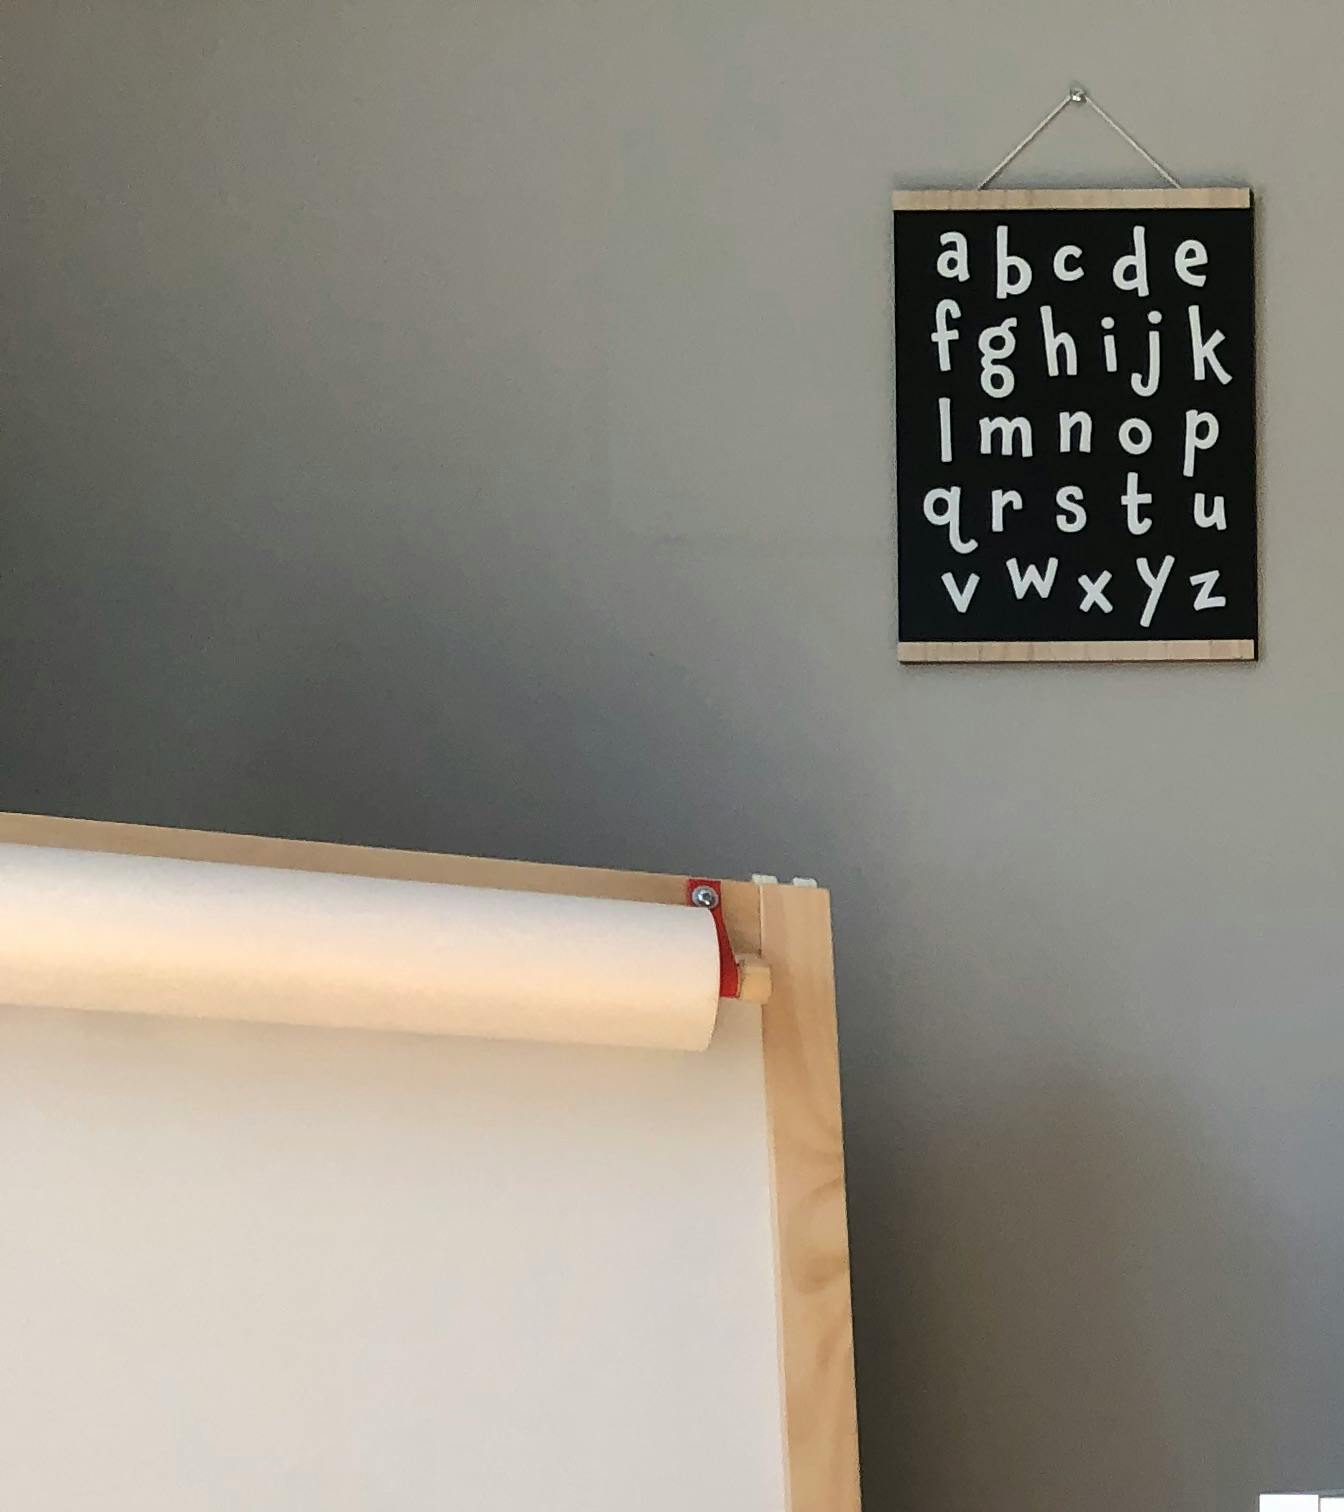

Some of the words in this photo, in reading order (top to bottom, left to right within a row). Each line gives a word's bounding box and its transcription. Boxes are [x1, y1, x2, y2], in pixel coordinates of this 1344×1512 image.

[936, 231, 970, 281] a
[996, 225, 1032, 299] b
[1053, 245, 1084, 281] c
[1113, 225, 1149, 297] d
[1174, 239, 1208, 287] e
[931, 298, 961, 371] f
[978, 317, 1017, 398] g
[1040, 305, 1078, 376] h
[1101, 316, 1117, 372] i
[1131, 310, 1163, 396] j
[1189, 305, 1232, 385] k
[938, 397, 952, 462] l
[979, 414, 1033, 458] m
[1059, 411, 1092, 453] n
[1118, 417, 1152, 455] o
[1183, 409, 1219, 477] p
[923, 486, 978, 554] q
[992, 489, 1022, 532] r
[1056, 485, 1087, 533] s
[1121, 472, 1152, 535] t
[1193, 492, 1227, 531] u
[941, 571, 980, 613] v
[1005, 557, 1058, 600] w
[1077, 570, 1113, 613] x
[1136, 554, 1175, 628] y
[1189, 570, 1226, 611] z
